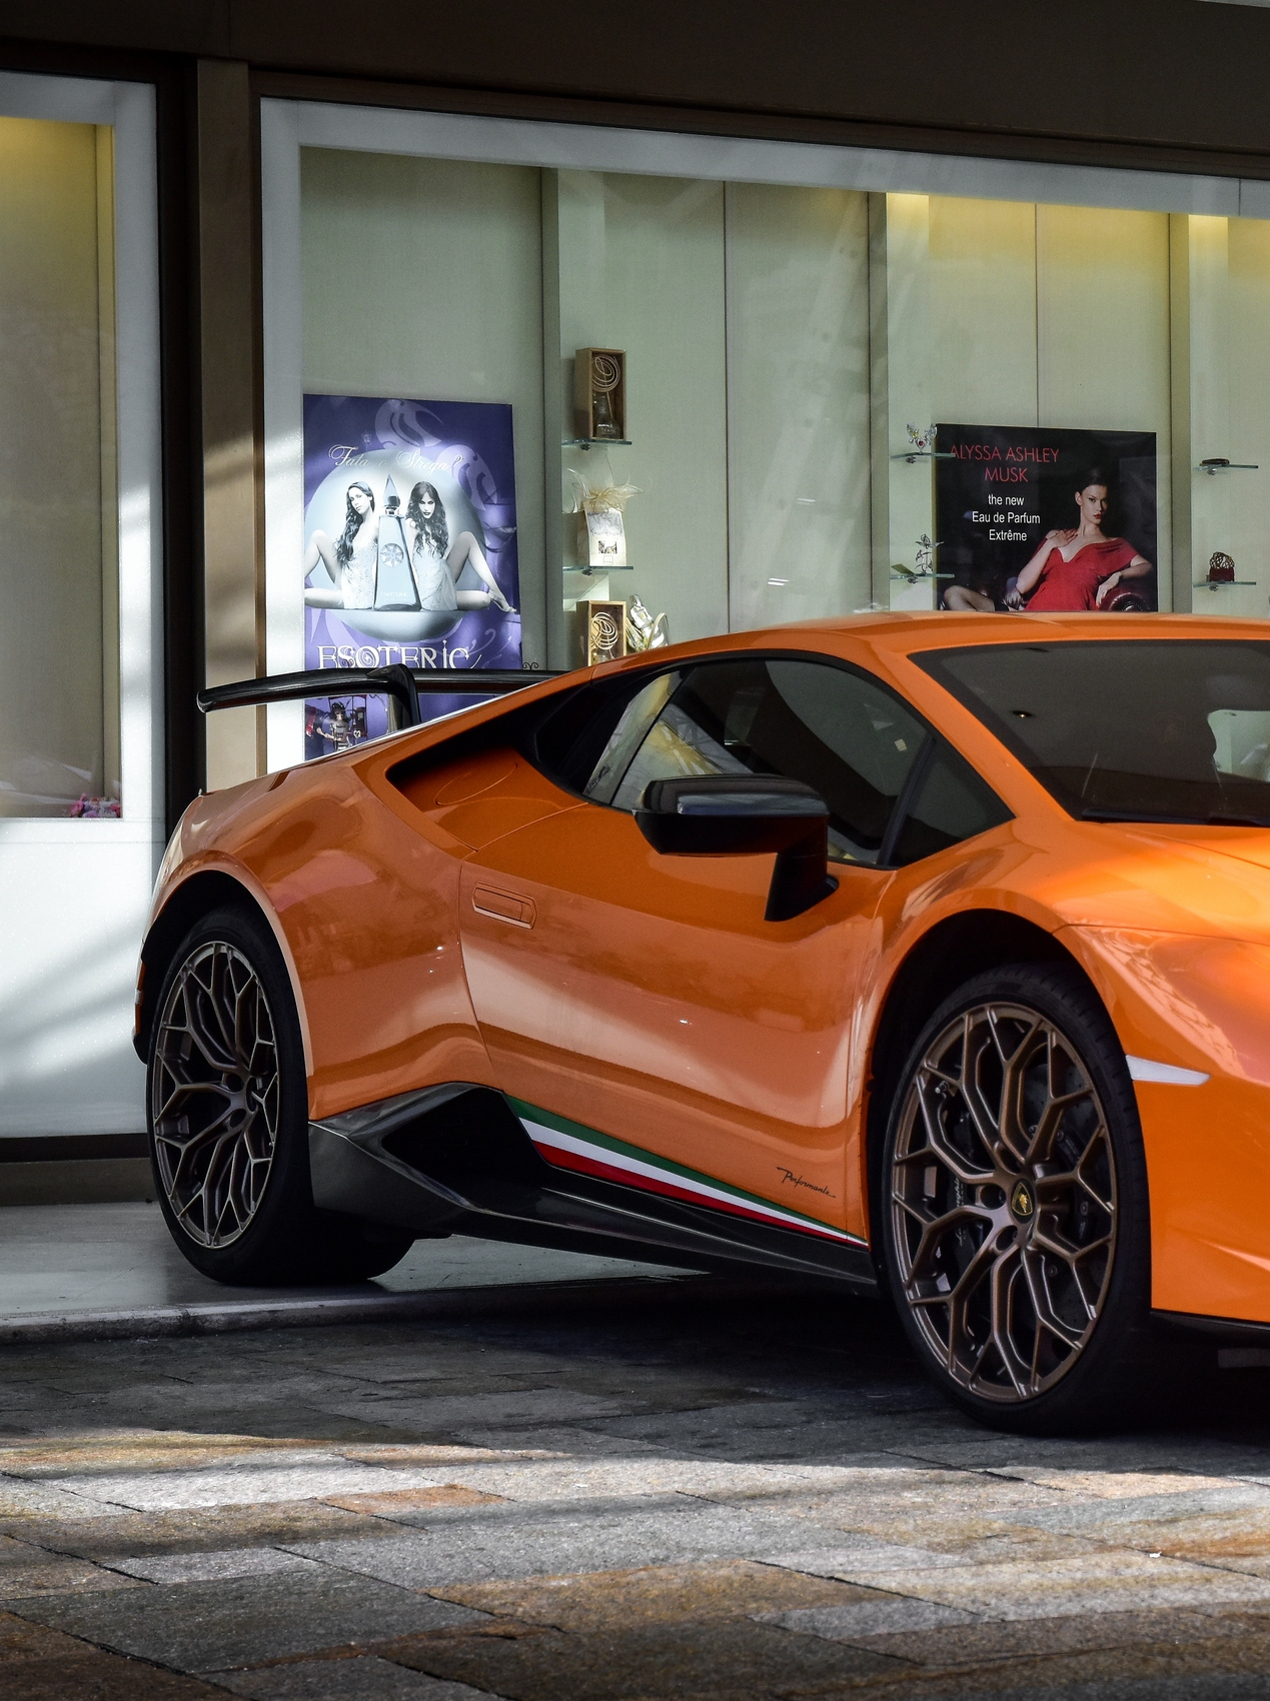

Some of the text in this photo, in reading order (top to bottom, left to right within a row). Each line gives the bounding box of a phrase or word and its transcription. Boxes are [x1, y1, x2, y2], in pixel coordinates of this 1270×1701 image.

[950, 445, 1060, 462] ALYSSA ASHLEY
[985, 467, 1028, 482] MUSK
[988, 494, 1025, 505] the new
[972, 511, 1041, 523] Eau de Parfum
[989, 529, 1028, 541] Extrême
[317, 640, 481, 668] ESOTERIC
[776, 1167, 836, 1198] Performante
